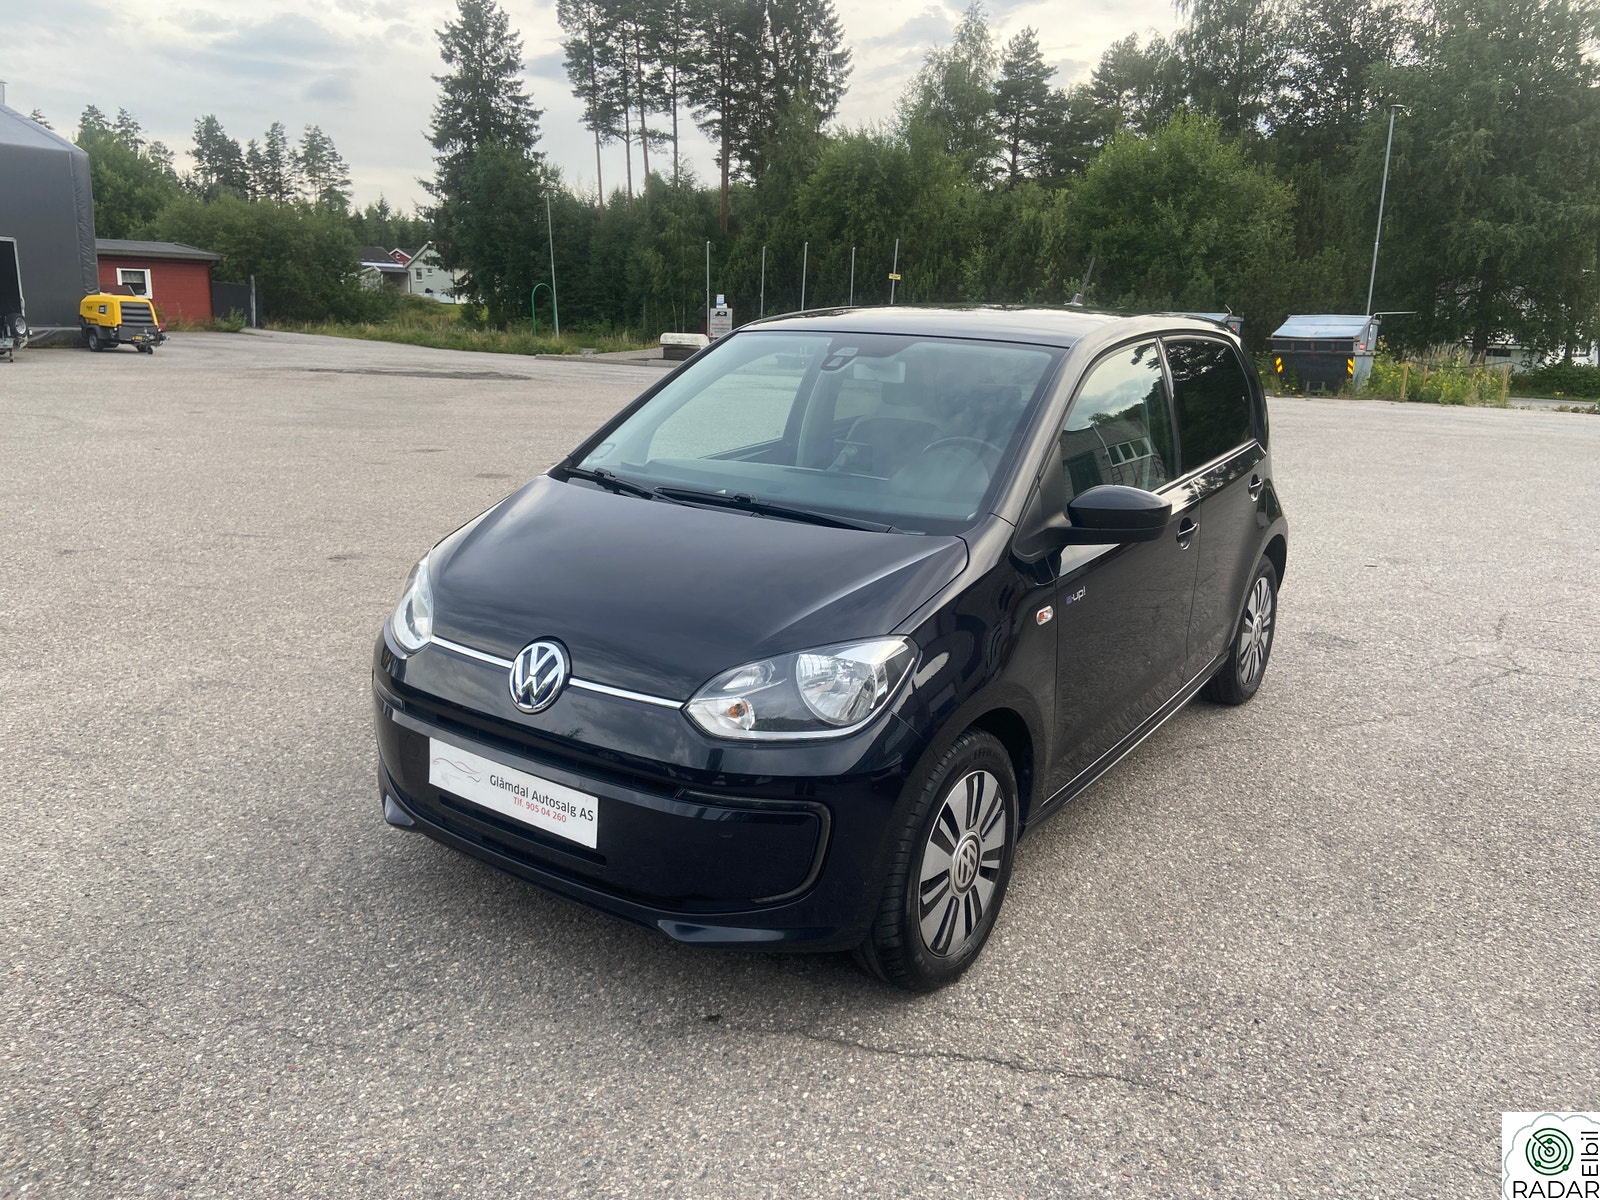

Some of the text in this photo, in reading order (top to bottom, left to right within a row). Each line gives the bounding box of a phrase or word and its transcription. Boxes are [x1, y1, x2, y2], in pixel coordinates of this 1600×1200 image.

[489, 774, 594, 822] Glåmdal Autosalg AS
[525, 801, 539, 813] 905
[541, 807, 551, 817] 04
[552, 811, 567, 823] 260
